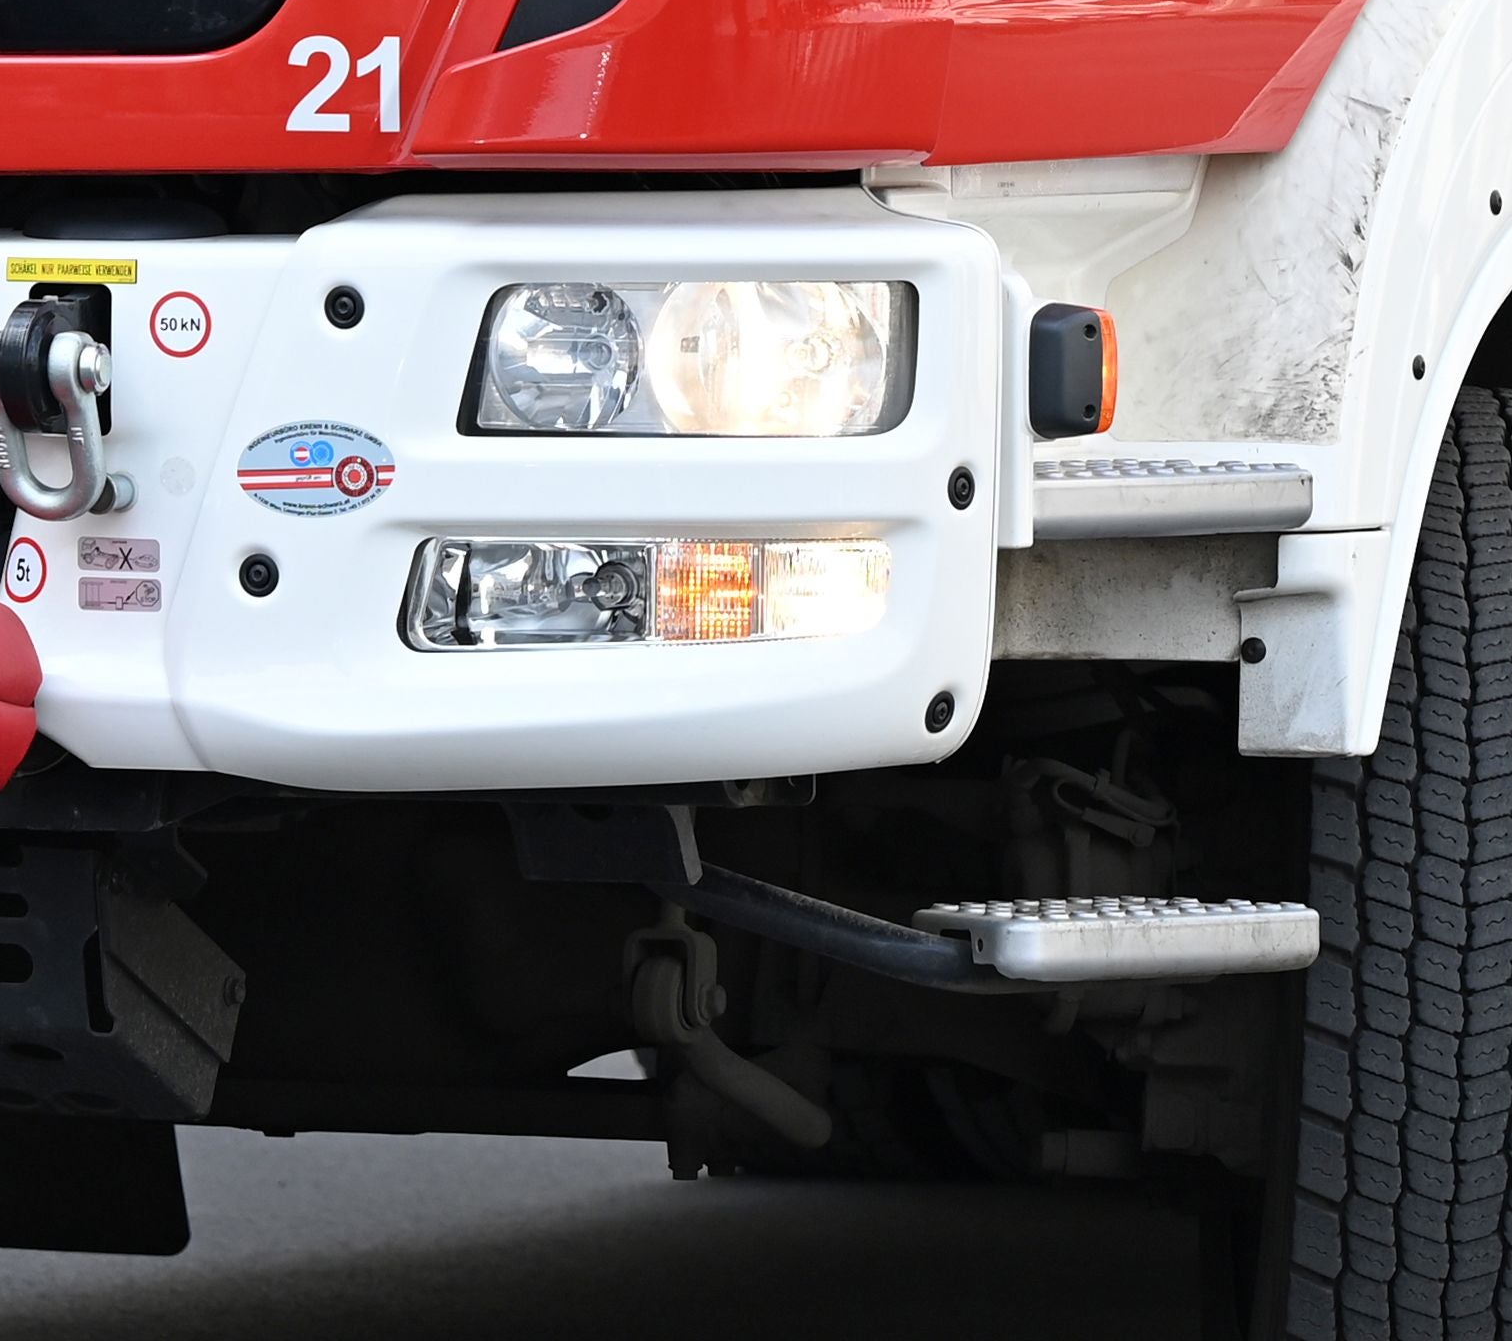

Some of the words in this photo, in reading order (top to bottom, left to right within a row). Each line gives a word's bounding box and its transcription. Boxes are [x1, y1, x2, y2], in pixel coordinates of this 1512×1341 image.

[285, 34, 402, 132] 21
[160, 318, 177, 331] 50
[181, 318, 201, 331] kN
[16, 558, 31, 582] 5t
